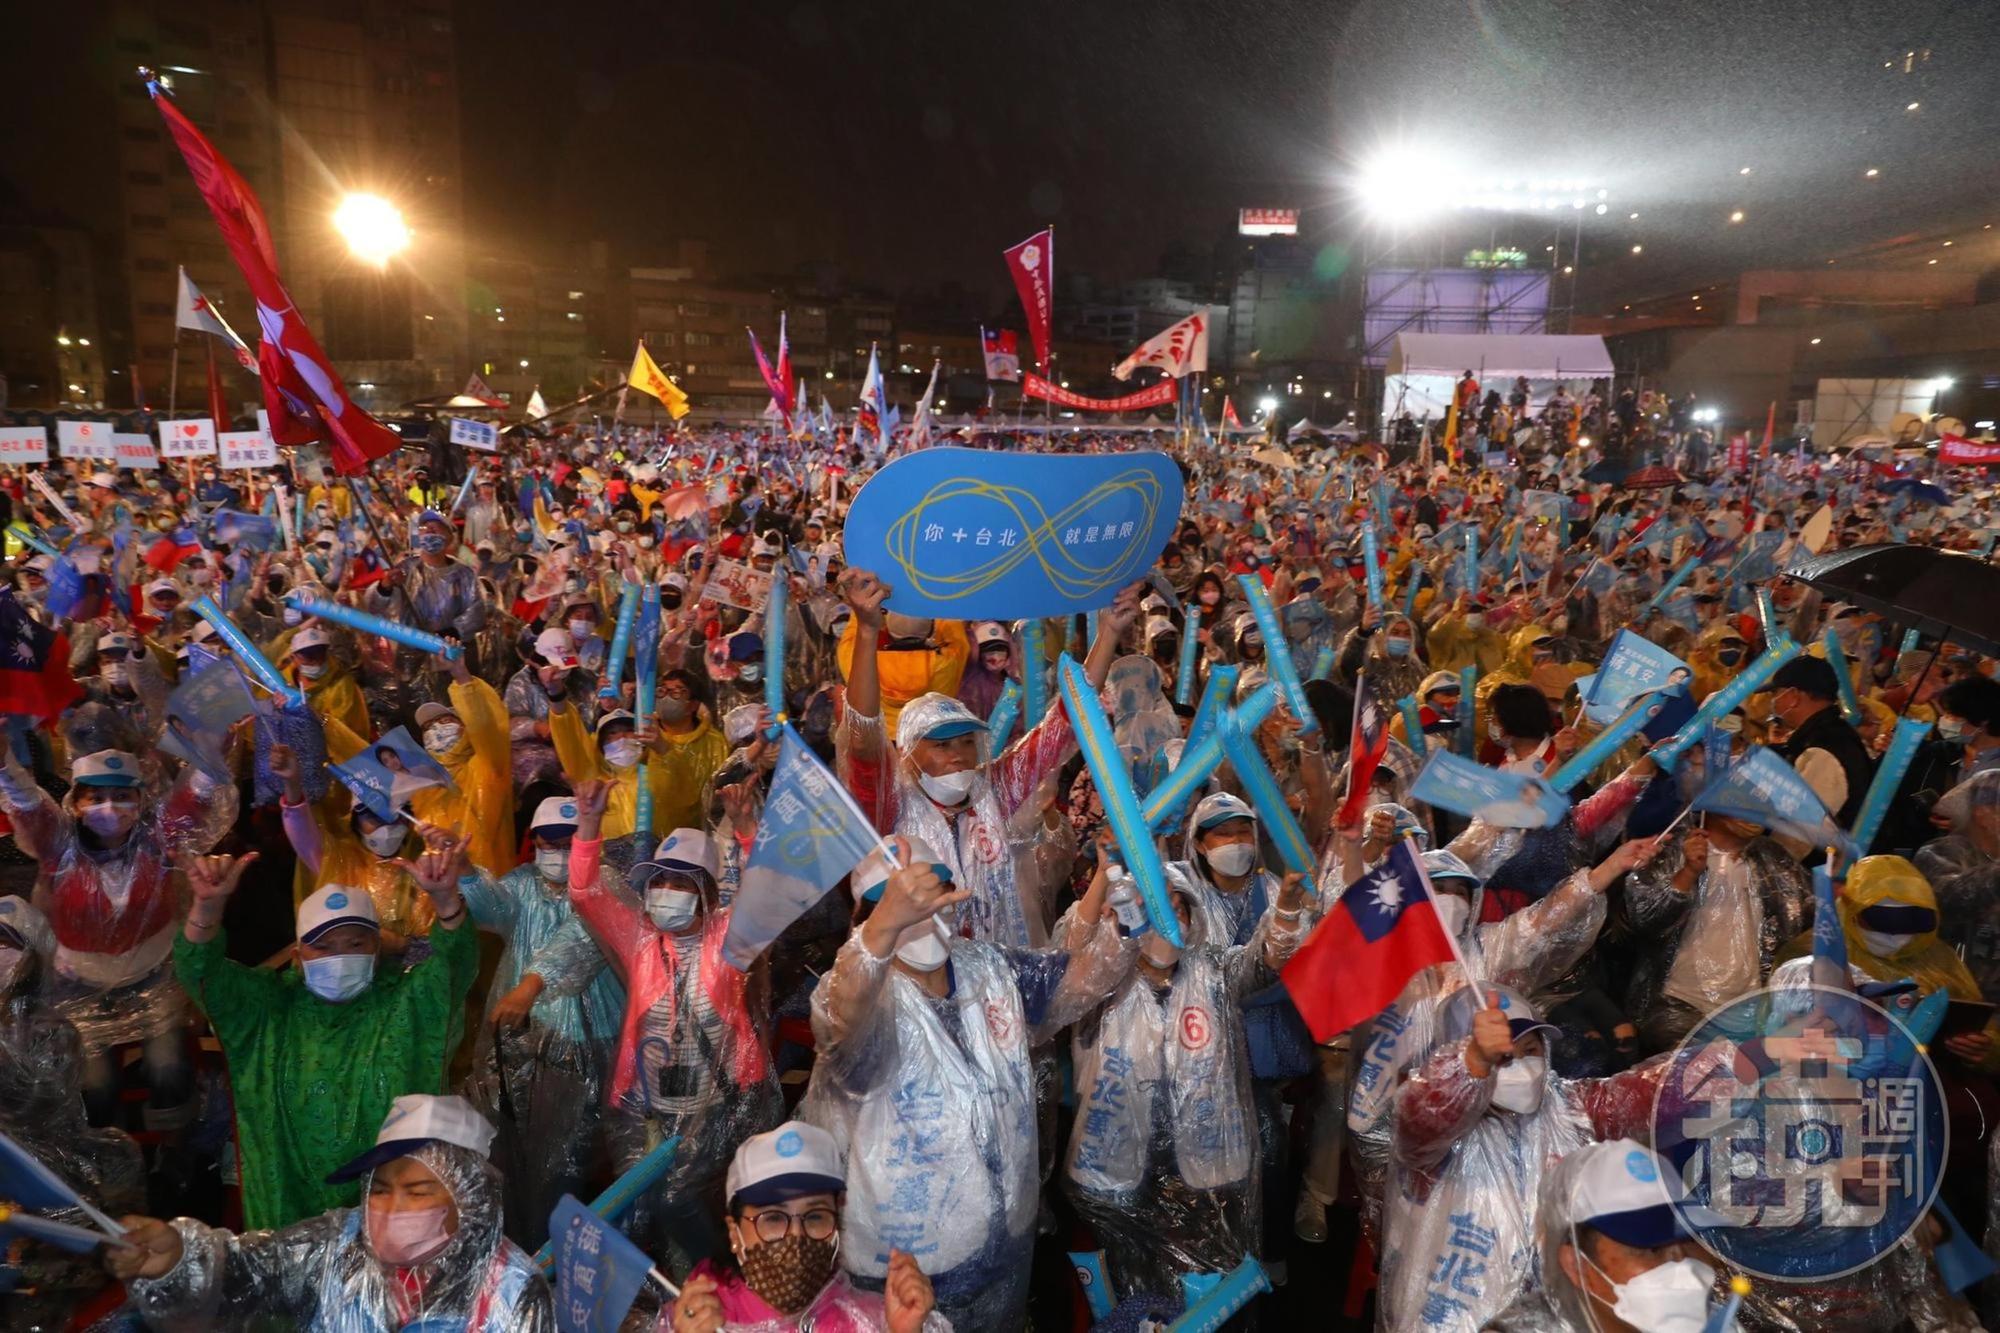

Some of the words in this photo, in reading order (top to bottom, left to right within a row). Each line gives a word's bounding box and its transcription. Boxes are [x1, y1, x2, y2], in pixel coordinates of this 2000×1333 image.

[169, 439, 208, 451] 蔣萬安
[228, 449, 270, 461] 蔣萬安
[1064, 521, 1135, 546] 就是無限
